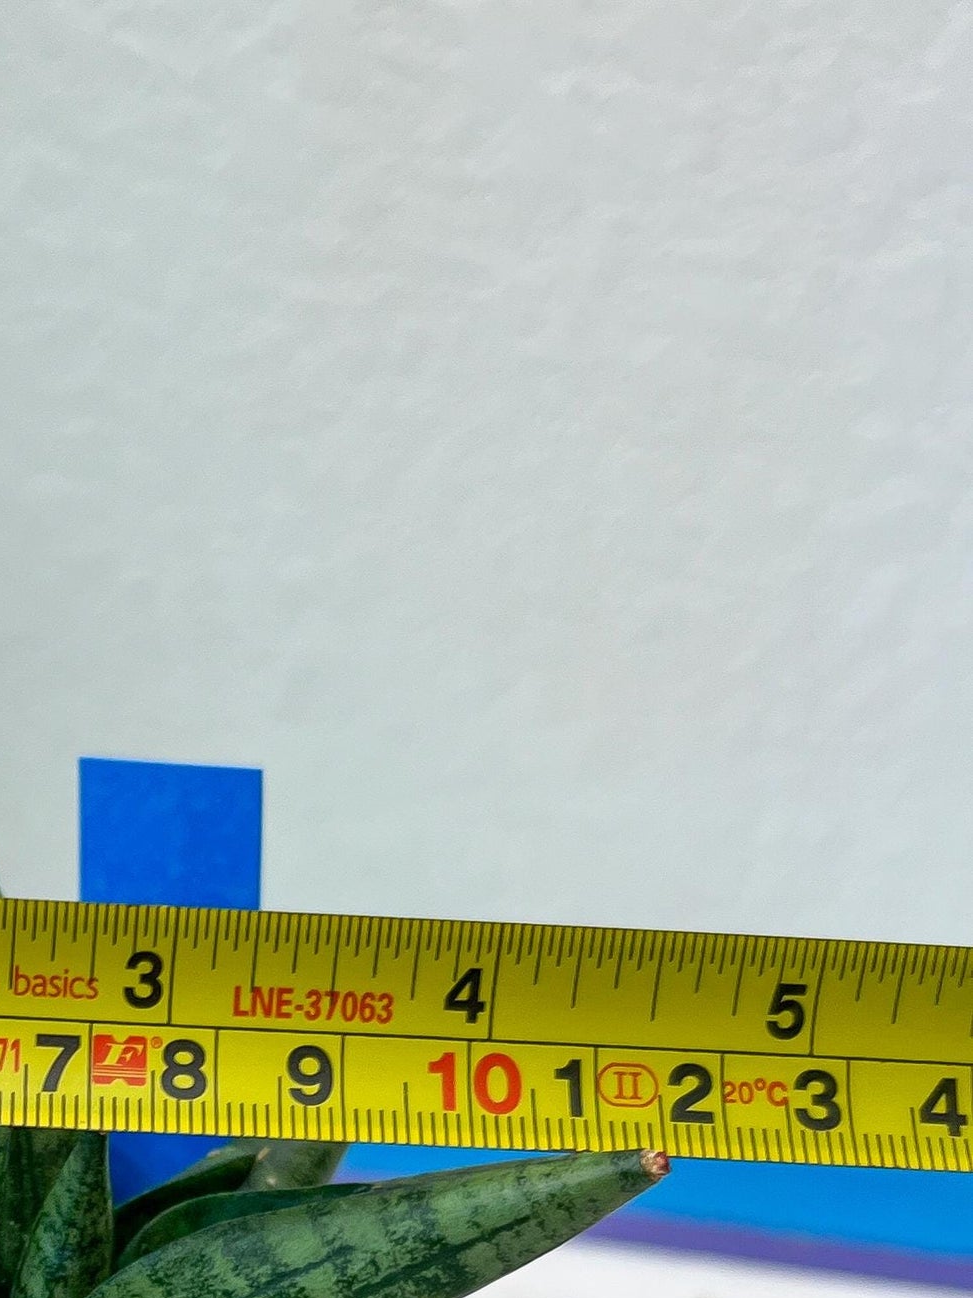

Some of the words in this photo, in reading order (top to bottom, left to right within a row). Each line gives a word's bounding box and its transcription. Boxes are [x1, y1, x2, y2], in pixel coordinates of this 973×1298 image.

[12, 965, 99, 1000] basics
[124, 951, 163, 1009] 3
[232, 985, 394, 1024] LNE-37063
[443, 967, 486, 1024] 4
[765, 983, 808, 1040] 5
[35, 1034, 82, 1092] 7
[161, 1039, 206, 1101] 8
[287, 1044, 334, 1107] 9
[428, 1051, 522, 1116] 10
[554, 1058, 584, 1118] 1
[668, 1063, 715, 1124] 2
[793, 1069, 842, 1132] 3
[920, 1077, 967, 1137] 4
